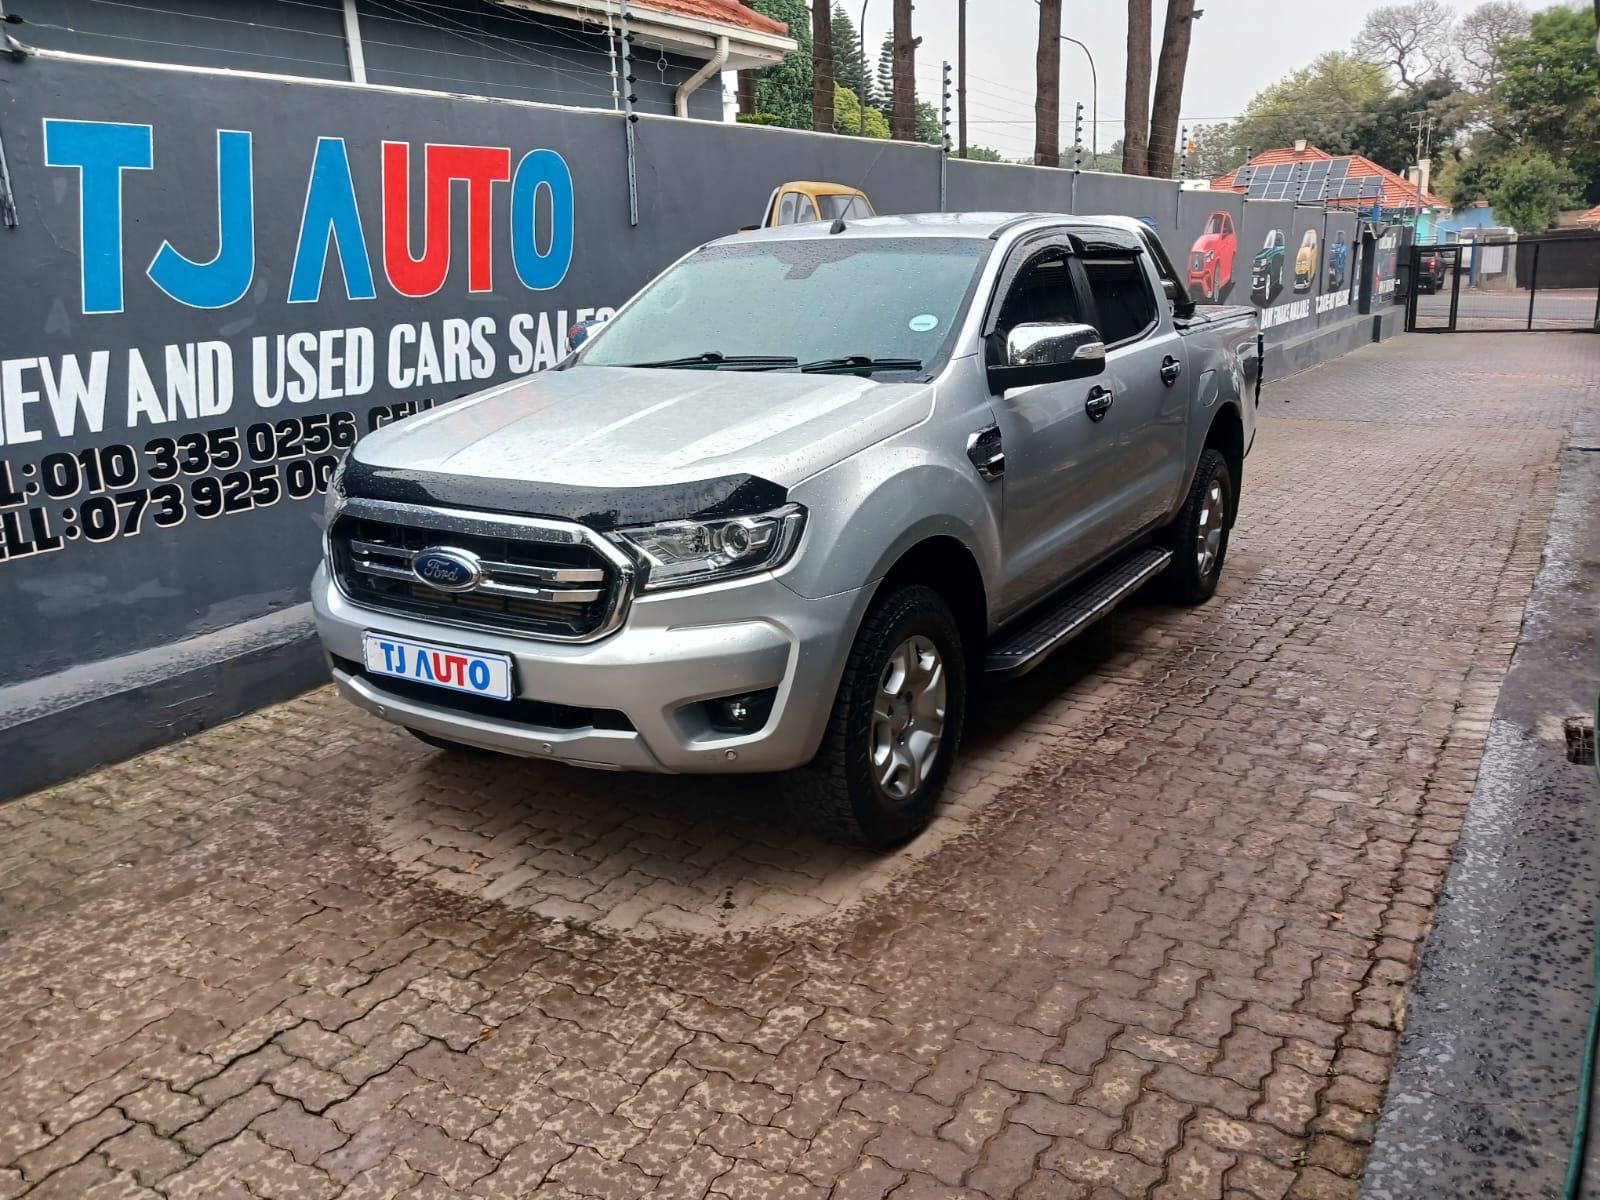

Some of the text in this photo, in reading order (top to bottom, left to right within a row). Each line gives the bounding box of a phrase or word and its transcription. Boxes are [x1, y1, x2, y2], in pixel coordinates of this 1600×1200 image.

[42, 117, 575, 315] TJ AUTO
[0, 306, 616, 446] EW AND USED CARS SAL
[144, 426, 241, 482] 335
[246, 412, 357, 464] 0256
[191, 463, 282, 528] 925
[424, 558, 458, 582] Ford
[380, 641, 491, 691] TJ AUTO
